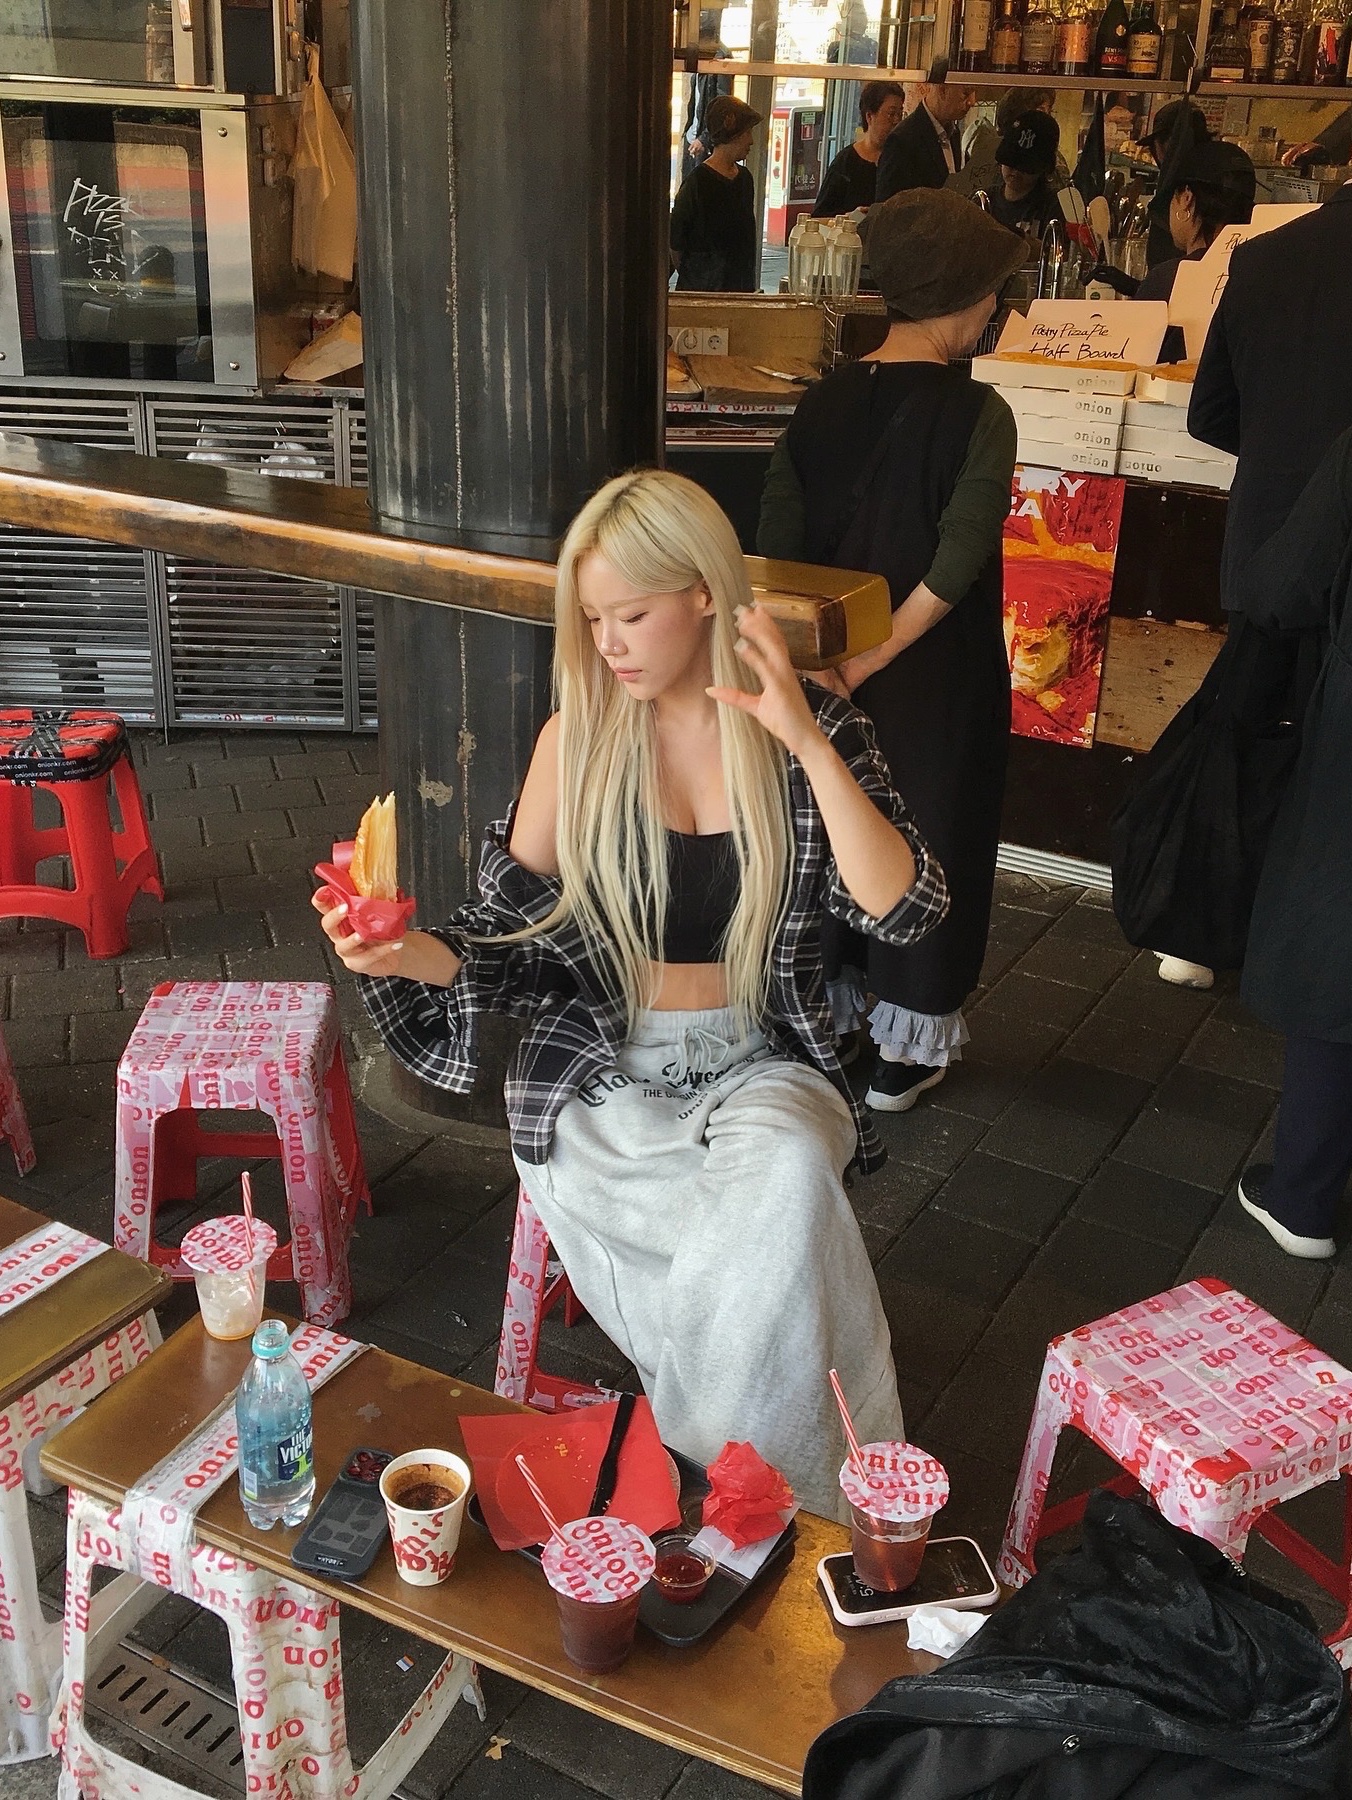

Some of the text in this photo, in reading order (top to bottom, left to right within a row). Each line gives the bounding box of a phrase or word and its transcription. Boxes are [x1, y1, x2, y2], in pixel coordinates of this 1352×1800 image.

[1060, 323, 1089, 338] Pizza
[1086, 323, 1110, 340] Pie
[1075, 401, 1112, 415] onion
[1074, 428, 1111, 446] onion
[1072, 452, 1109, 468] onion
[643, 1089, 663, 1098] THE
[131, 1146, 149, 1216] onion
[586, 1520, 640, 1589] onion
